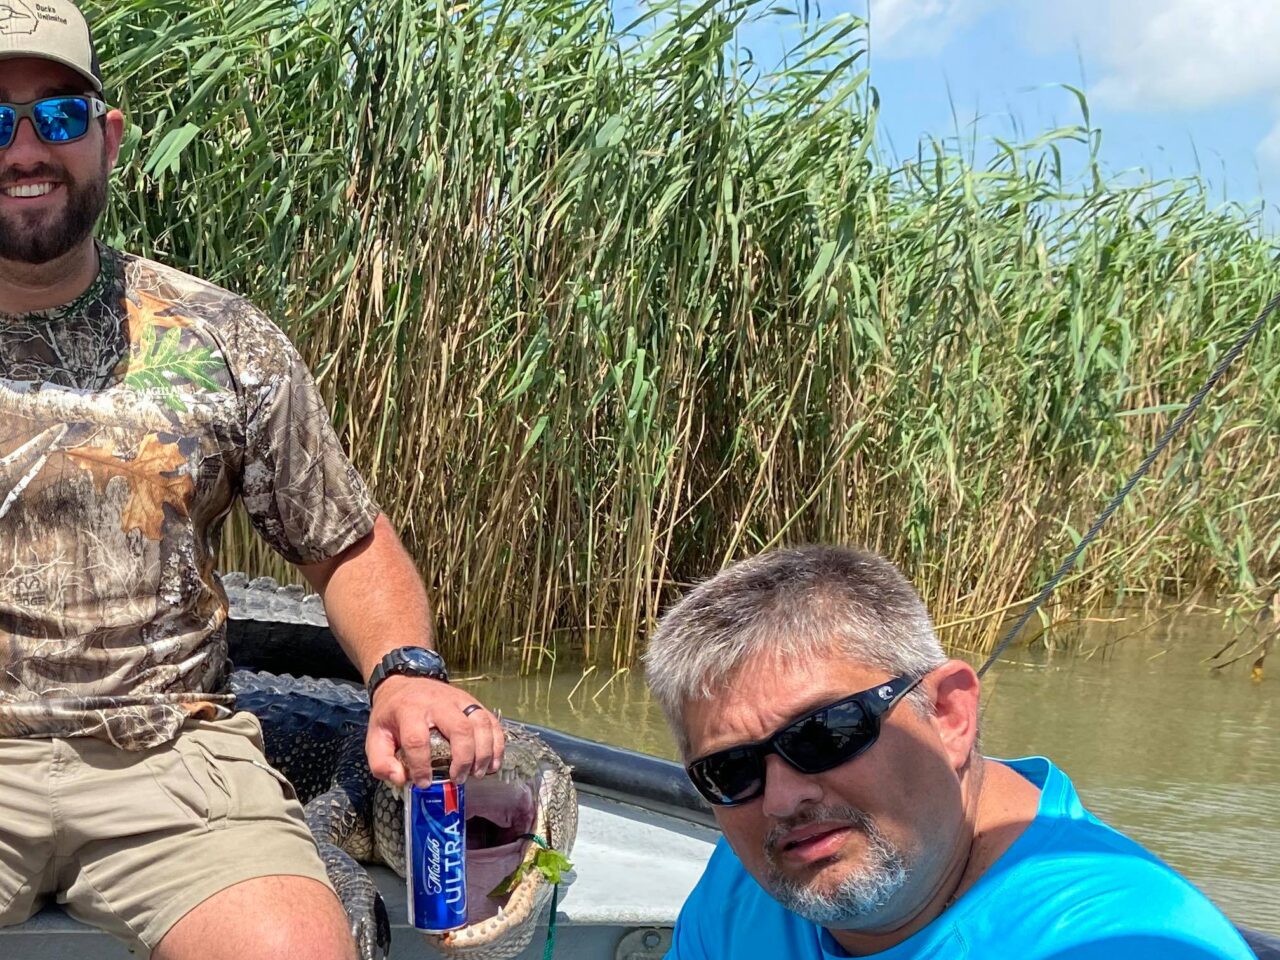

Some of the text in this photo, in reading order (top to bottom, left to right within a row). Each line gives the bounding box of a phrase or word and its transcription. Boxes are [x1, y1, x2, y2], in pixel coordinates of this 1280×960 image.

[35, 3, 56, 13] Ducks
[37, 12, 68, 25] Unlimited
[427, 837, 441, 895] Michelob
[443, 818, 461, 905] ULTRA
